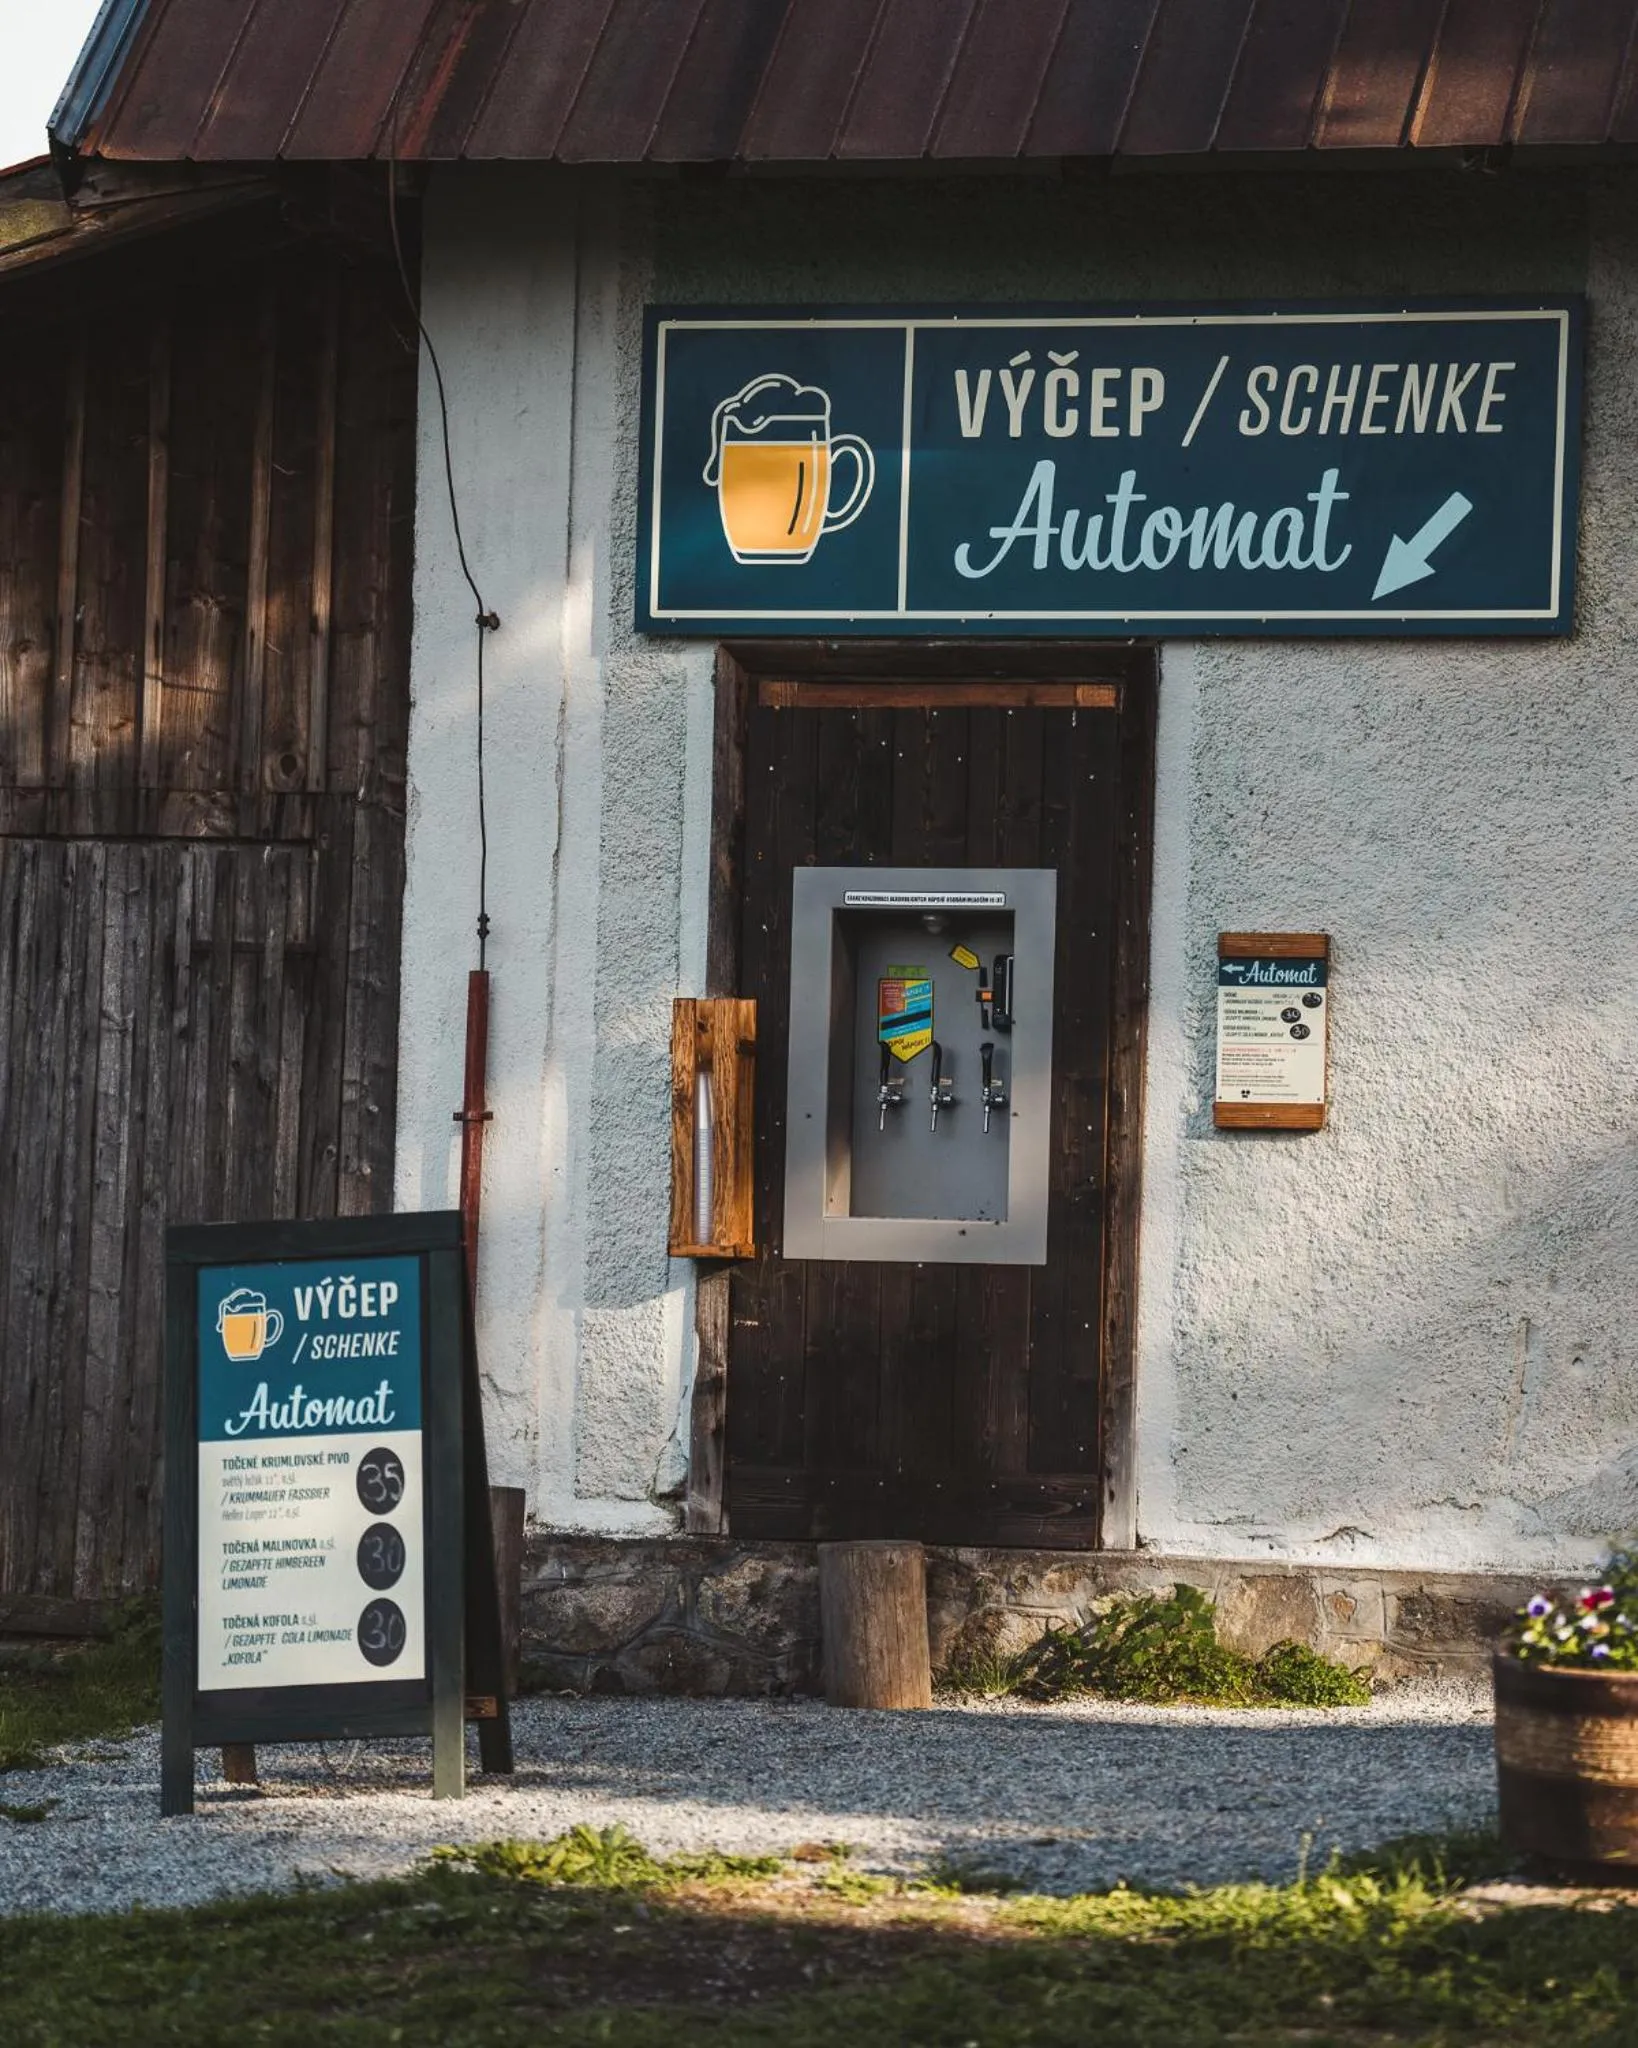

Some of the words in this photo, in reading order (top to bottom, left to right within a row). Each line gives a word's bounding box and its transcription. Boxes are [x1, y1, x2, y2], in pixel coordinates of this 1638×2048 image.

[954, 350, 1166, 438] VÝČEP
[1238, 361, 1517, 436] SCHENKE
[953, 458, 1353, 579] Automat
[1239, 960, 1317, 984] Automat
[293, 1274, 399, 1321] VÝČEP
[311, 1330, 401, 1361] SCHENKE
[224, 1380, 395, 1436] Automat
[222, 1456, 258, 1471] TOČENÉ
[261, 1453, 325, 1469] KRUMLOVSKÉ
[327, 1452, 350, 1464] PIVO
[361, 1462, 403, 1502] 35
[222, 1539, 260, 1554] TOČENÁ
[262, 1538, 317, 1553] MALINOVKA
[363, 1536, 403, 1573] 30
[229, 1558, 273, 1573] GEZAPFTE
[222, 1575, 269, 1591] LIMONADE
[222, 1614, 260, 1630] TOČENÁ
[262, 1613, 300, 1628] KOFOLA
[361, 1609, 405, 1651] 30
[232, 1632, 277, 1648] GEZAPFTE
[281, 1631, 305, 1645] COLA
[307, 1628, 354, 1643] LIMONADE
